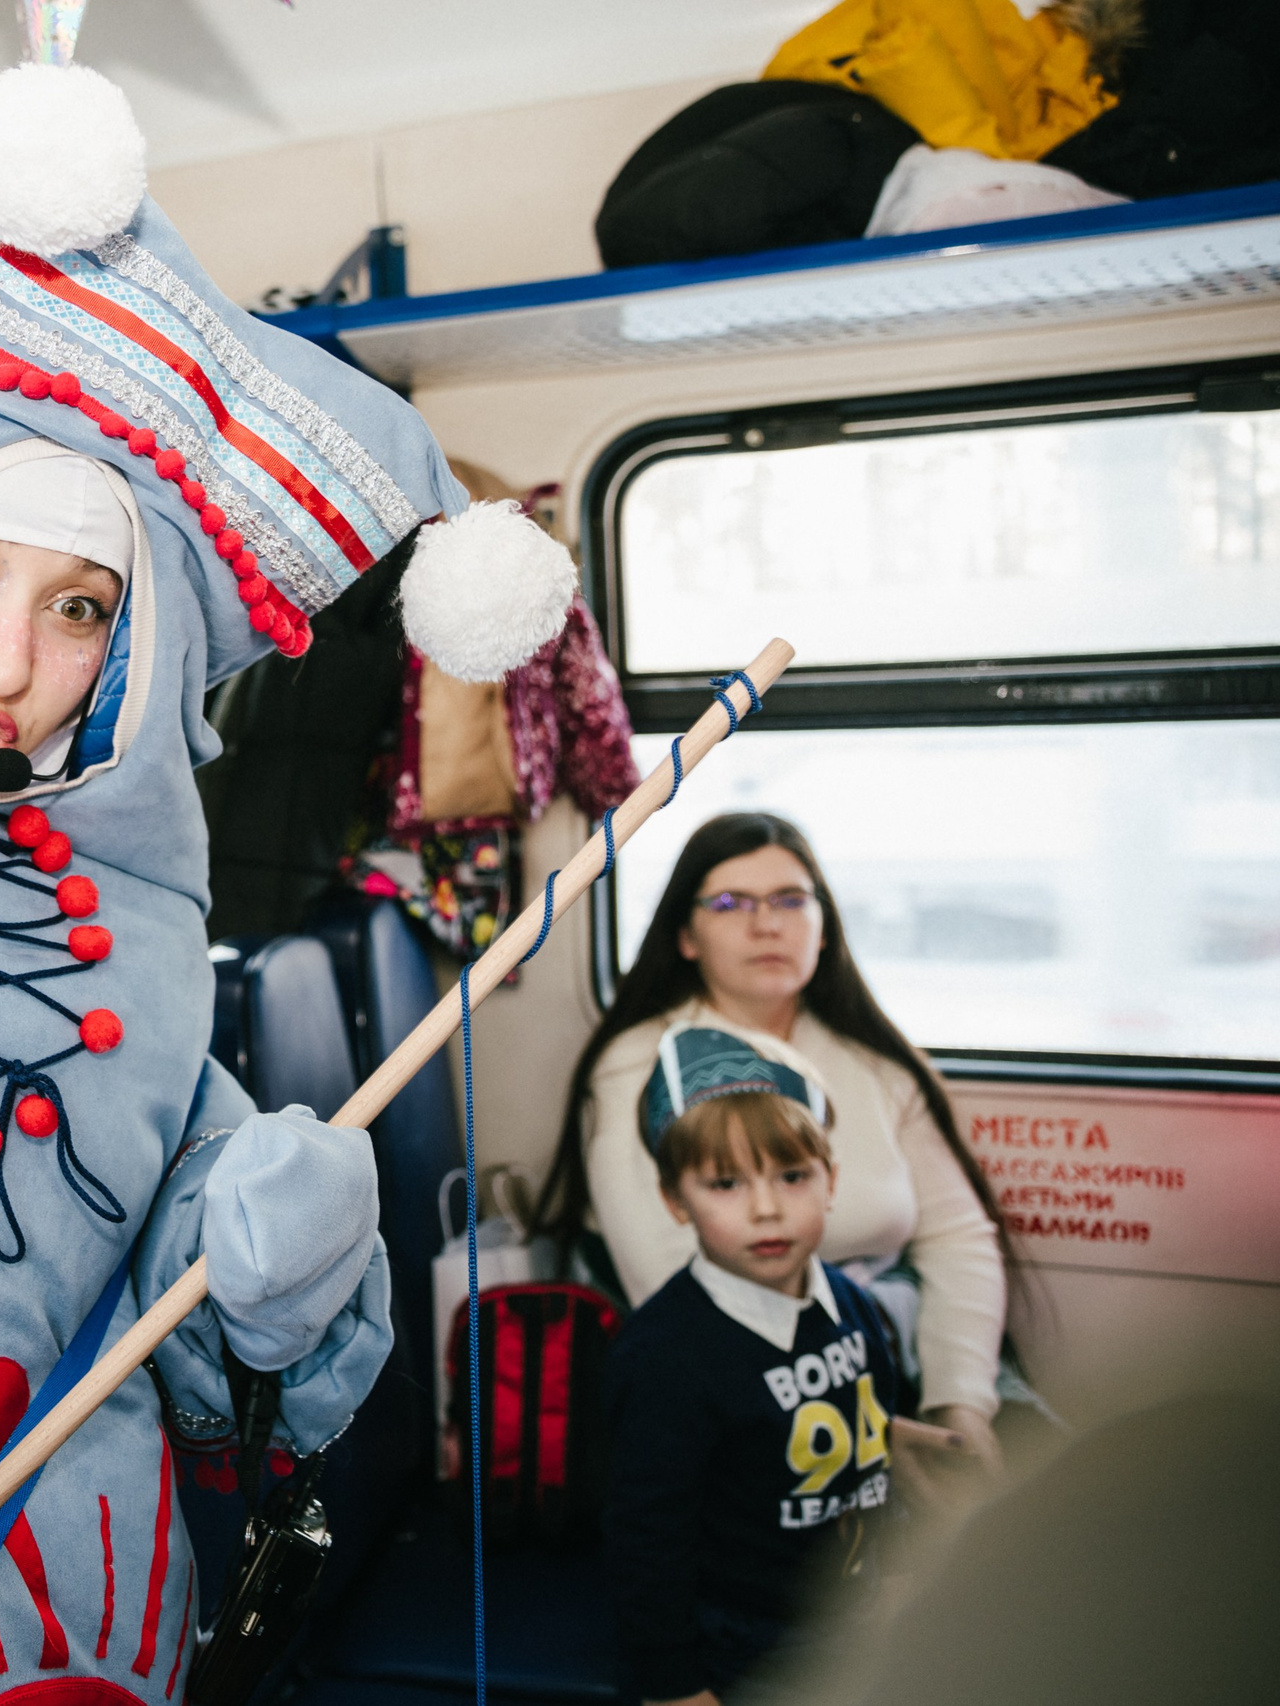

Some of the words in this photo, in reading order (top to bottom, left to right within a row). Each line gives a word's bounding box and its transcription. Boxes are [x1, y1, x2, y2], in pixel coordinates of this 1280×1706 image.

[970, 1114, 1110, 1152] МЕСТА
[763, 1330, 867, 1412] BORN
[786, 1372, 891, 1497] 94
